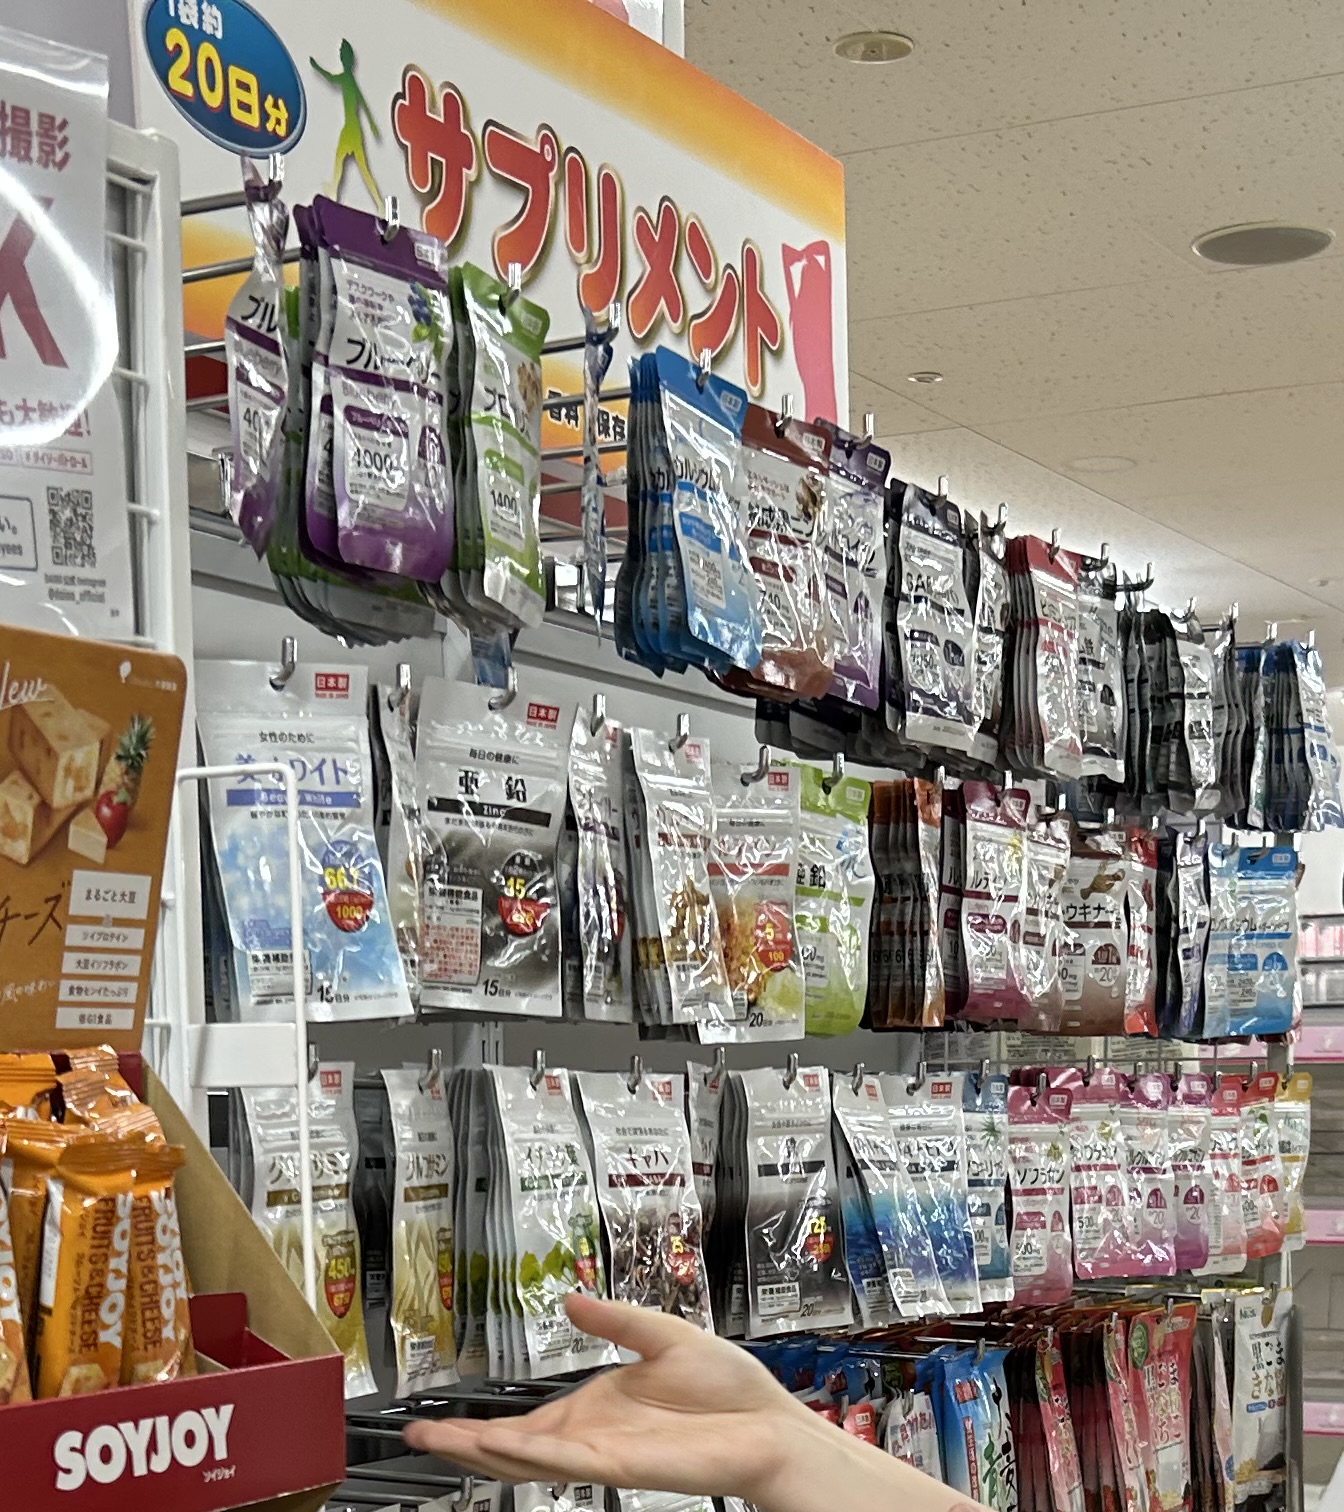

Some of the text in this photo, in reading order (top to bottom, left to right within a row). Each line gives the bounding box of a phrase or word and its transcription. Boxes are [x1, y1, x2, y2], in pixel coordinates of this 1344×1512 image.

[166, 29, 289, 140] 20日分
[393, 63, 784, 397] サプリメント
[315, 673, 349, 692] 日本製
[528, 703, 559, 721] 日本製
[258, 731, 315, 744] 女性のために
[469, 749, 519, 765] 毎日の健康に
[85, 888, 136, 904] まるごと大豆
[505, 877, 526, 900] 15
[98, 1191, 133, 1349] SOYJOY
[54, 1404, 235, 1491] SOYJOY
[202, 1464, 236, 1484] ソイジョイ
